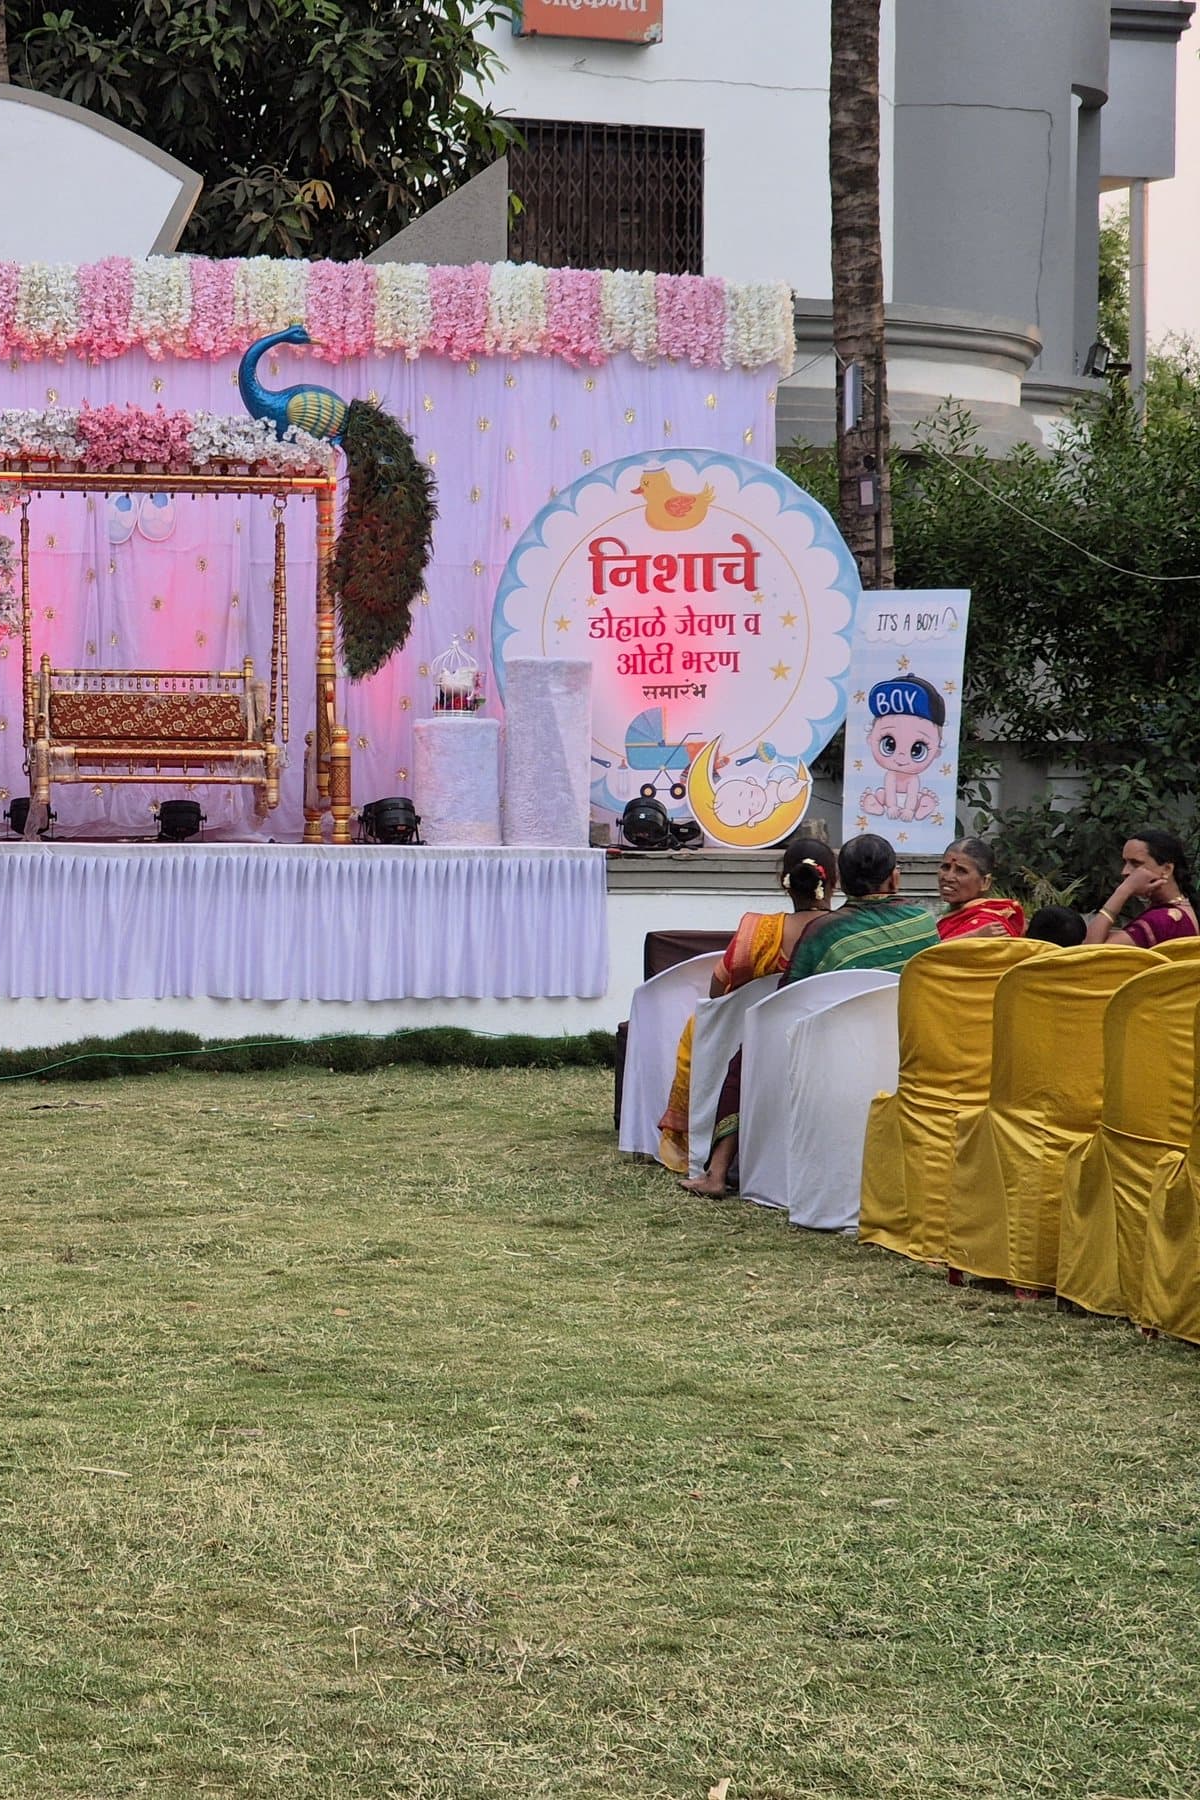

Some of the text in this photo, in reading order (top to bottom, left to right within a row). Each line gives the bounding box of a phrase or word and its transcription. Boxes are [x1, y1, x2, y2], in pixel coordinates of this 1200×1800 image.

[588, 533, 761, 595] निशाचे
[587, 605, 762, 642] डोहाळे जेवण व
[877, 613, 939, 632] IT'S A BOY!
[616, 642, 741, 675] ओटी भरण
[642, 678, 707, 700] समारंभ
[875, 688, 918, 715] BOY
